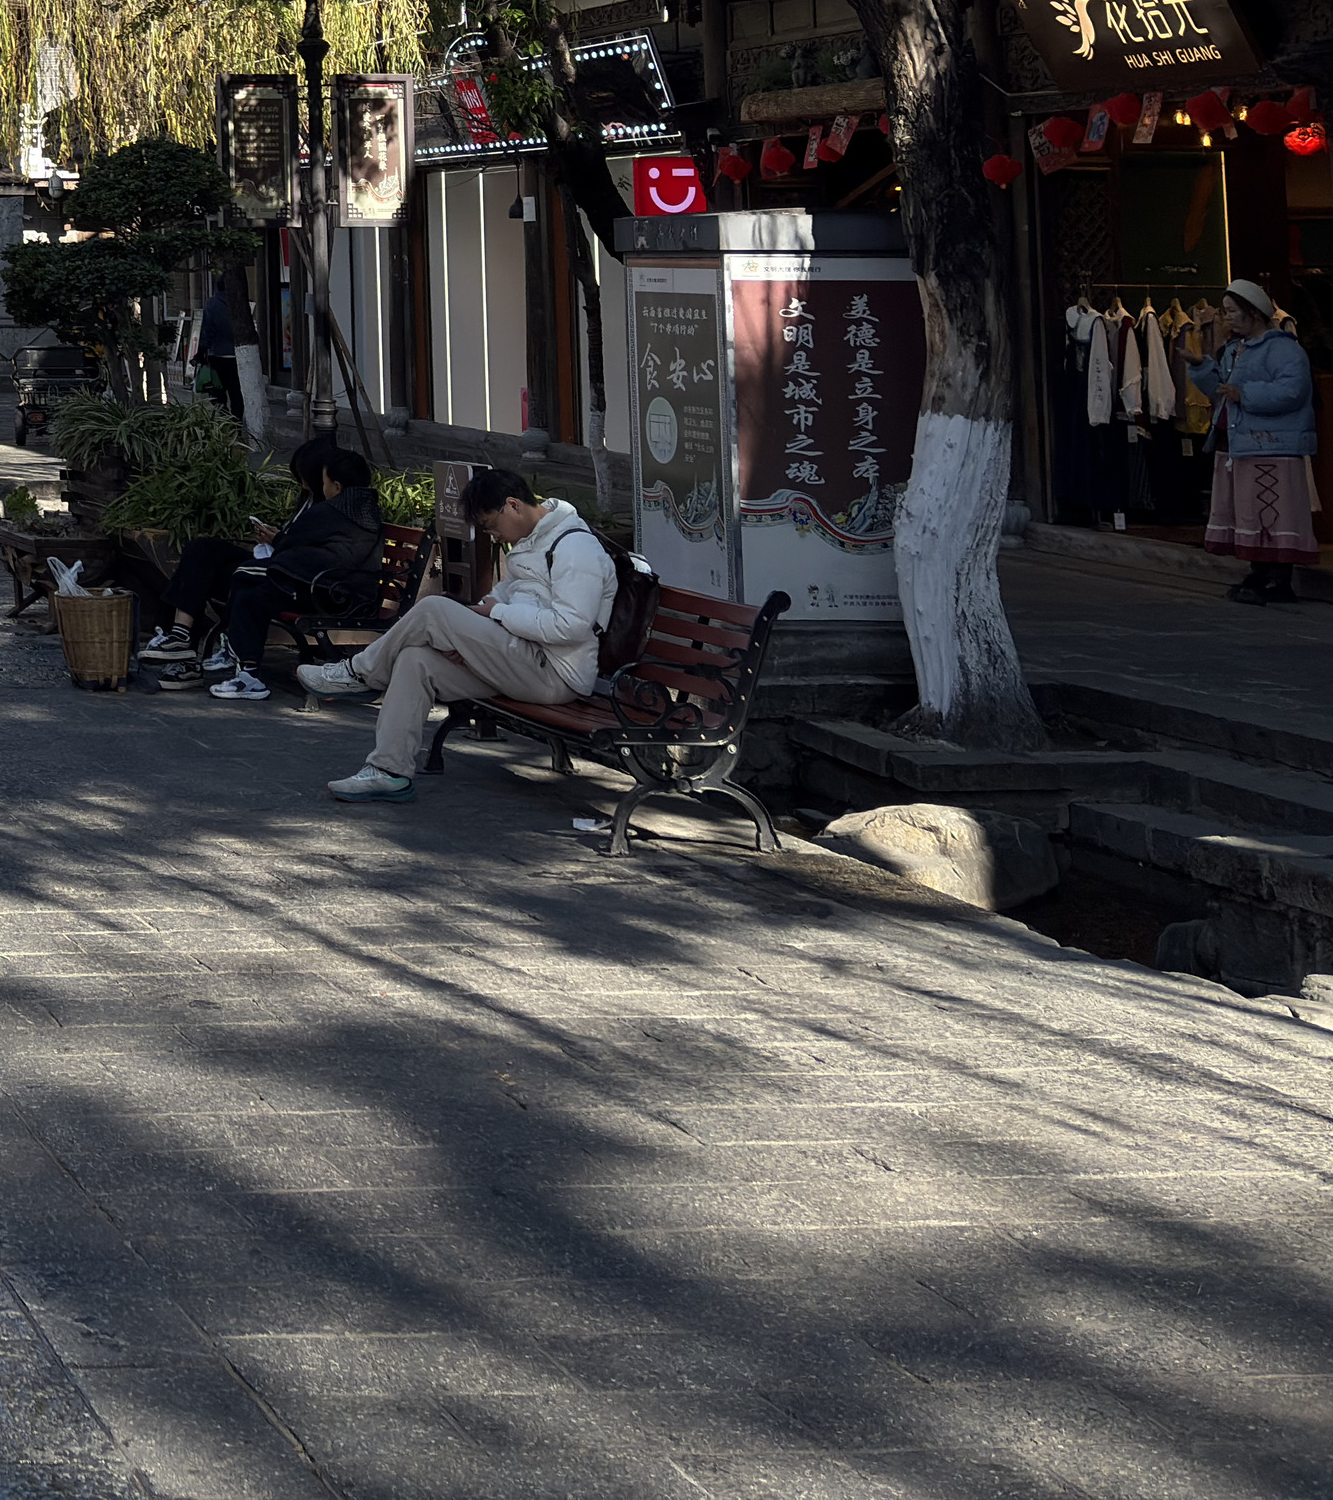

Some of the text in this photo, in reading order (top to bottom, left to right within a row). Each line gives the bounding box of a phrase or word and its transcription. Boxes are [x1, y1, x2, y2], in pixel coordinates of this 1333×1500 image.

[1124, 44, 1222, 69] HUA SHI GUANG
[640, 342, 715, 391] 食安心
[779, 296, 826, 485] 文明是城市之魂
[842, 293, 888, 485] 美德是立身之本
